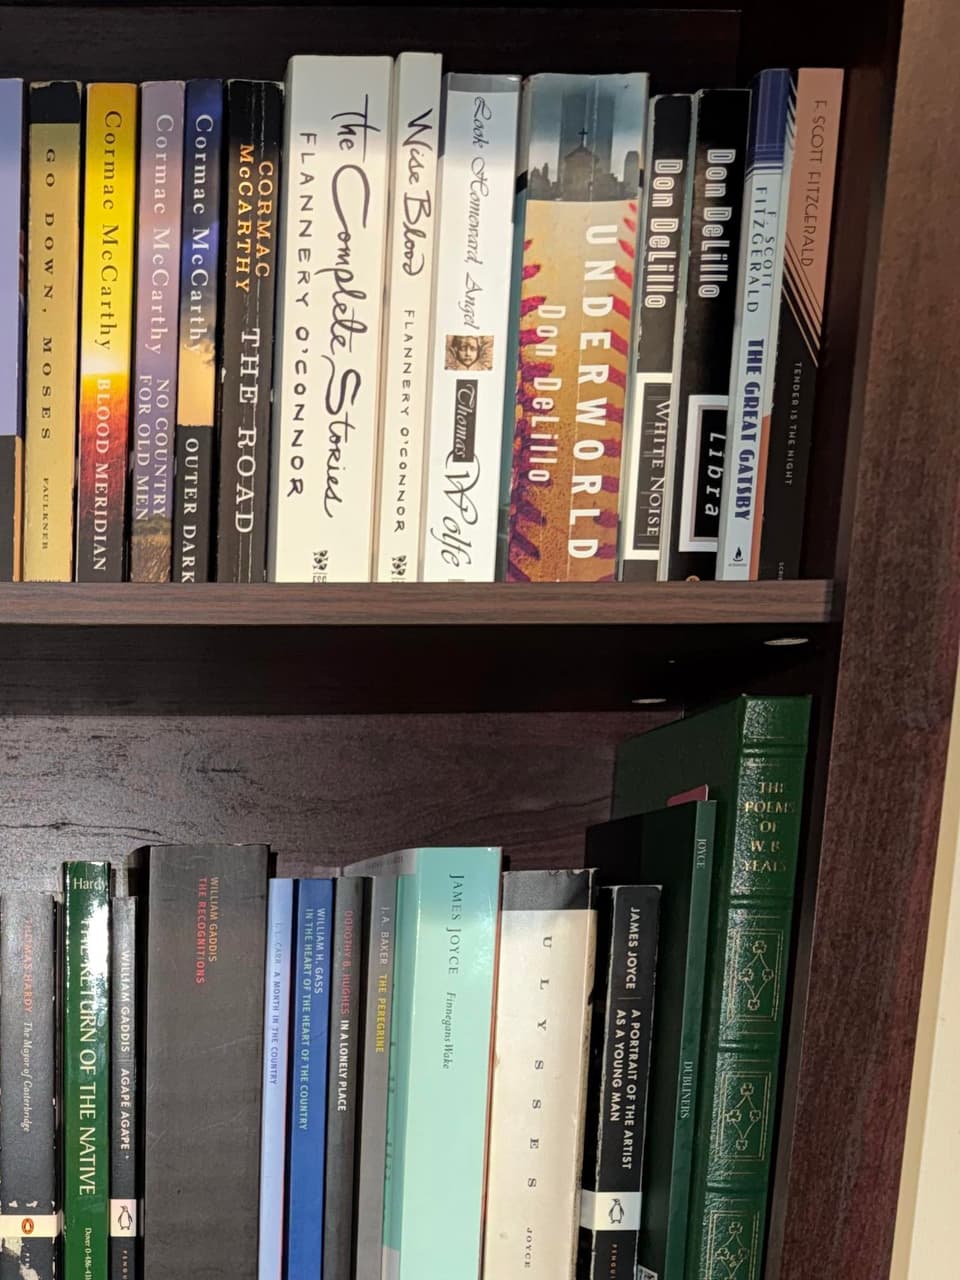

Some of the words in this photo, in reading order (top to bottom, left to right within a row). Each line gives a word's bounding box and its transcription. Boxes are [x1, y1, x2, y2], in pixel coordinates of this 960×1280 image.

[103, 110, 123, 210] Cormac
[255, 161, 274, 278] CORMAC
[95, 224, 119, 350] McCarthy
[239, 328, 260, 404] THE
[400, 310, 415, 416] FLANNERY
[535, 305, 566, 356] Don
[746, 339, 764, 375] THE
[95, 378, 111, 454] BLOOD
[138, 375, 152, 417] FOR
[156, 380, 170, 409] NO
[568, 225, 618, 559] UNDERWORLD
[741, 381, 761, 443] GREAT
[137, 424, 151, 466] OLD
[528, 377, 562, 482] DeLillo
[135, 476, 149, 521] MEN
[153, 418, 168, 518] COUNTRY
[183, 438, 200, 514] OUTER
[234, 427, 257, 533] ROAD
[394, 427, 410, 532] O'CONNOR
[704, 432, 727, 516] Libra
[735, 449, 756, 520] GATSBY
[93, 463, 111, 571] MERIDIAN
[73, 878, 106, 891] Hardy
[198, 878, 208, 898] THE
[450, 874, 464, 920] JAMES
[196, 901, 207, 984] RECOGNITIONS
[446, 928, 462, 975] JOYCE
[628, 907, 640, 947] JAMES
[626, 952, 638, 990] JOYCE
[376, 998, 387, 1053] PEREGRINE
[528, 936, 552, 1188] ULYSSES
[681, 1061, 693, 1118] DUBLINERS
[79, 1126, 96, 1196] NATIVE
